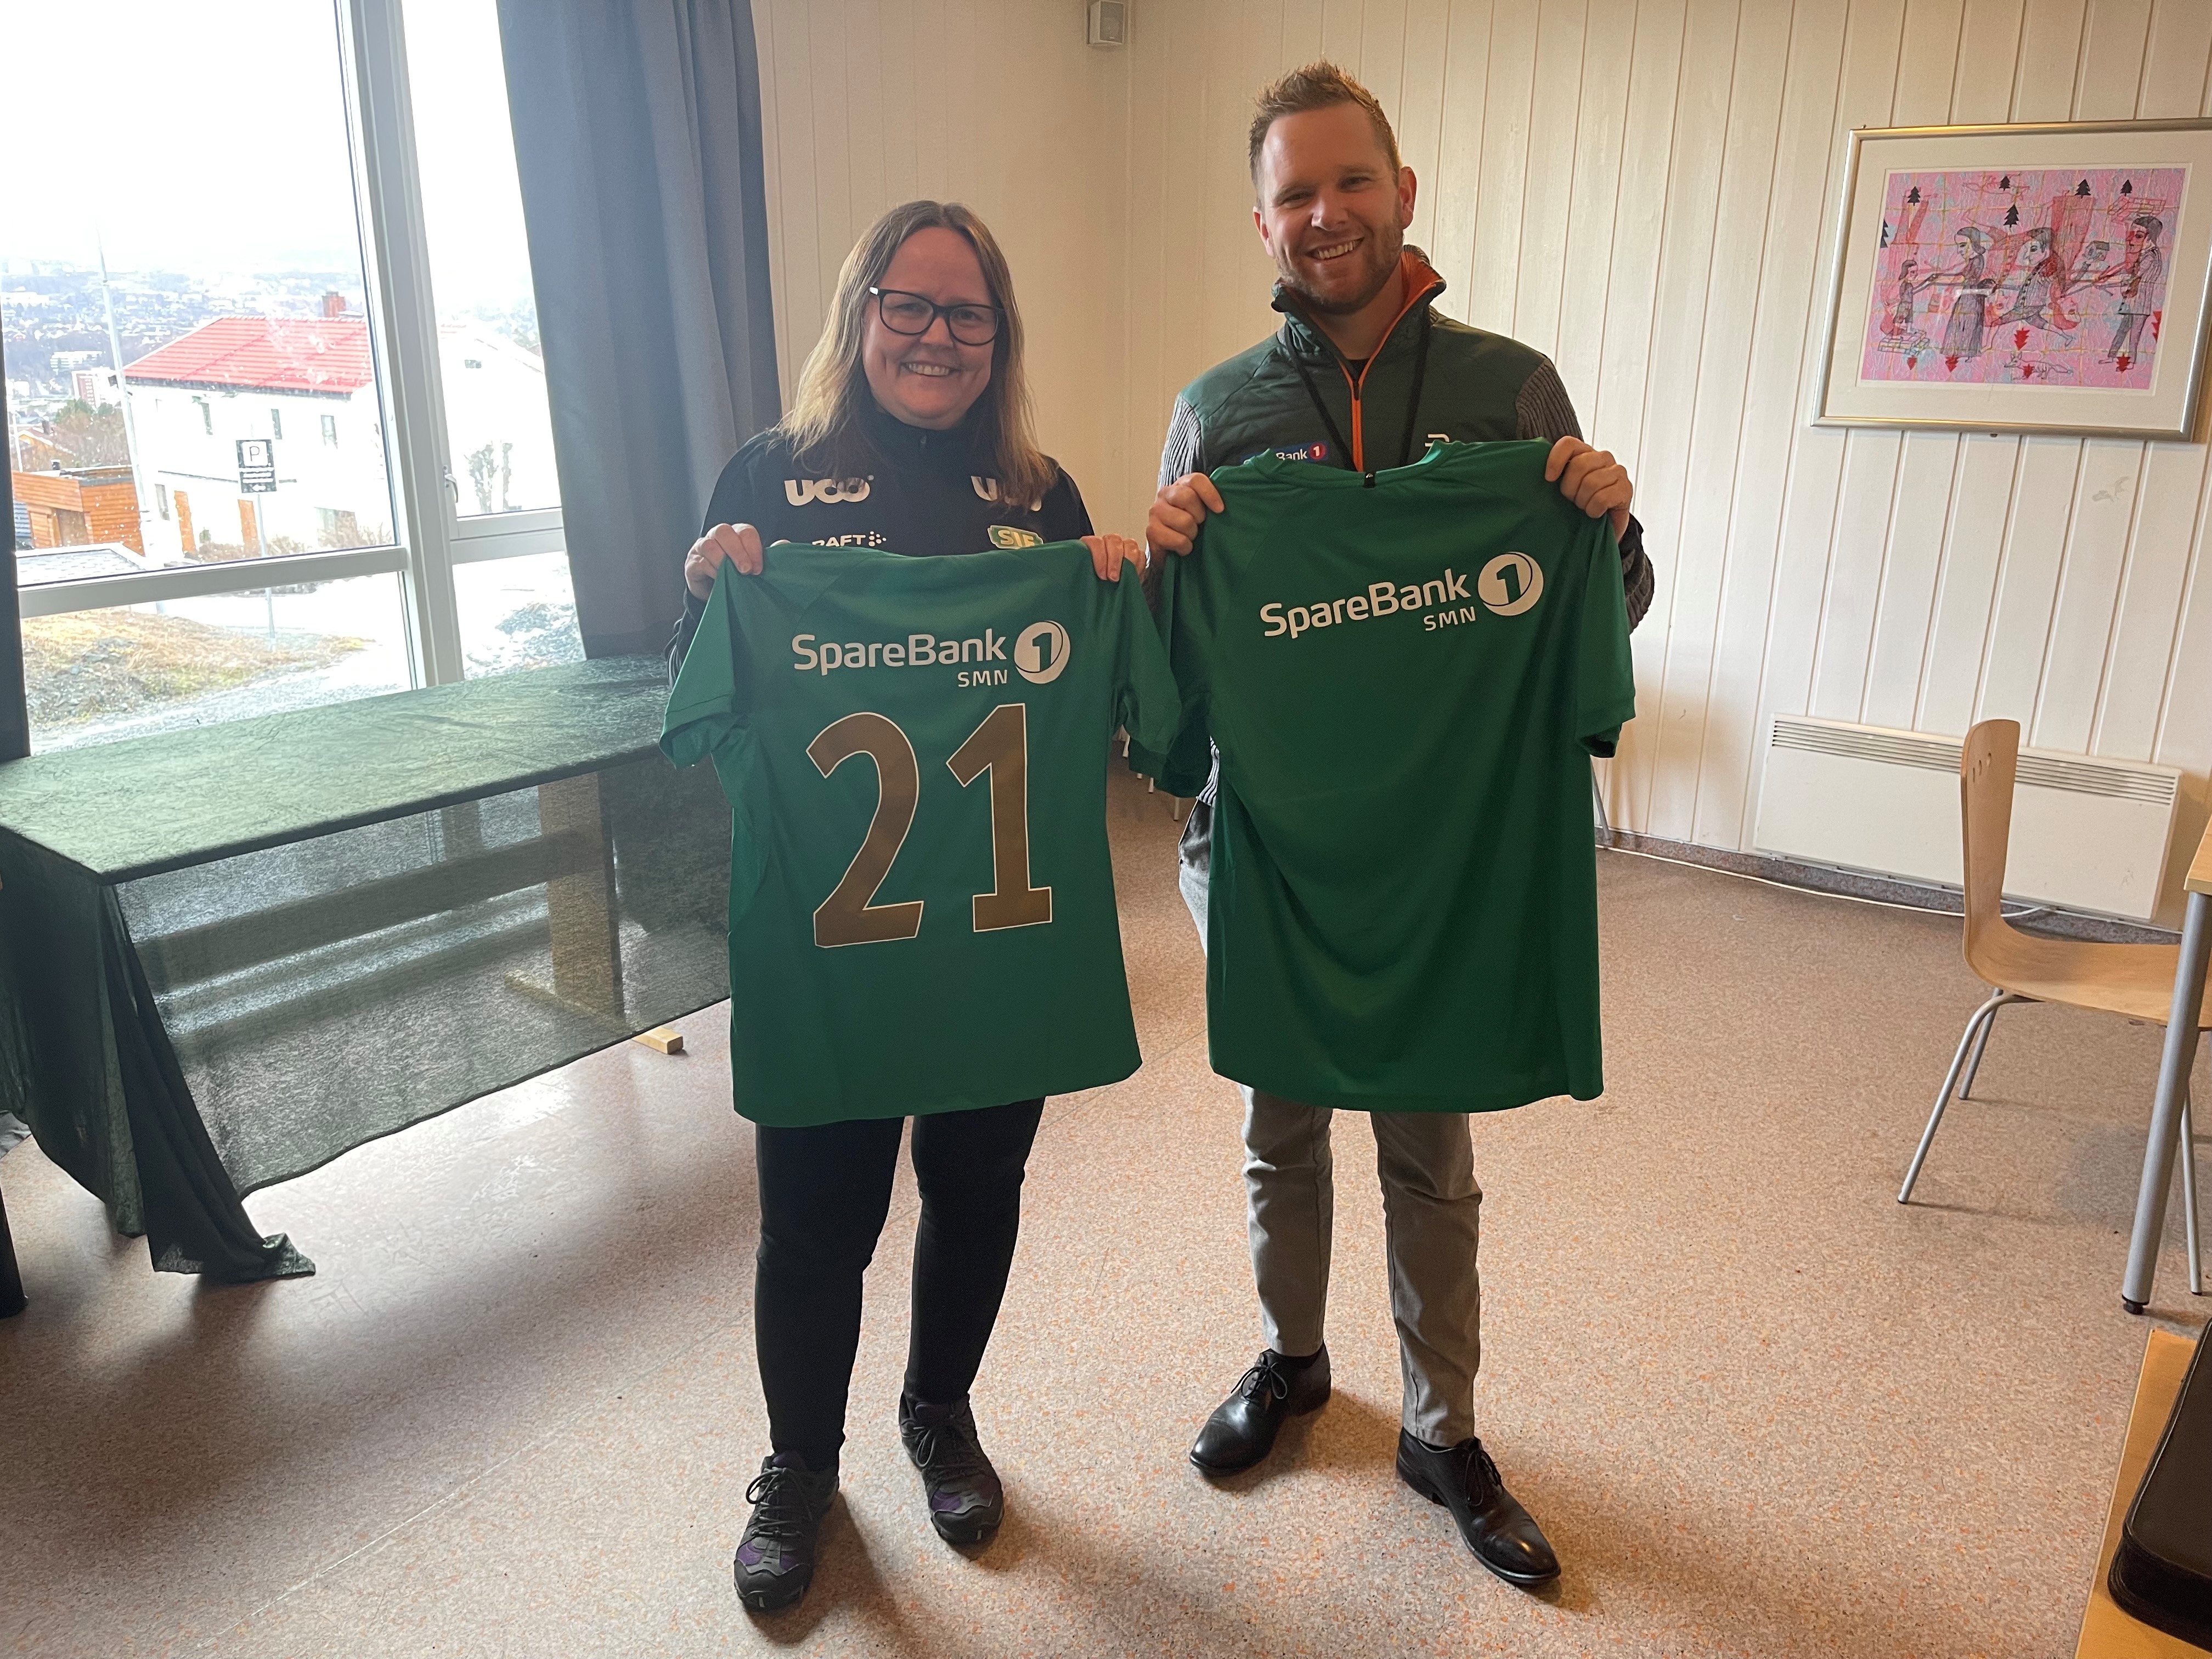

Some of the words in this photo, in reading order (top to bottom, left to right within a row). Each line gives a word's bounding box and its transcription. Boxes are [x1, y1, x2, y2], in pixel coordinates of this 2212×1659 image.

[249, 445, 260, 462] P
[1260, 568, 1471, 639] SpareBank
[1423, 606, 1476, 631] SMN
[791, 628, 1007, 676] SpareBank
[957, 669, 1008, 688] SMN
[805, 703, 1052, 948] 21
